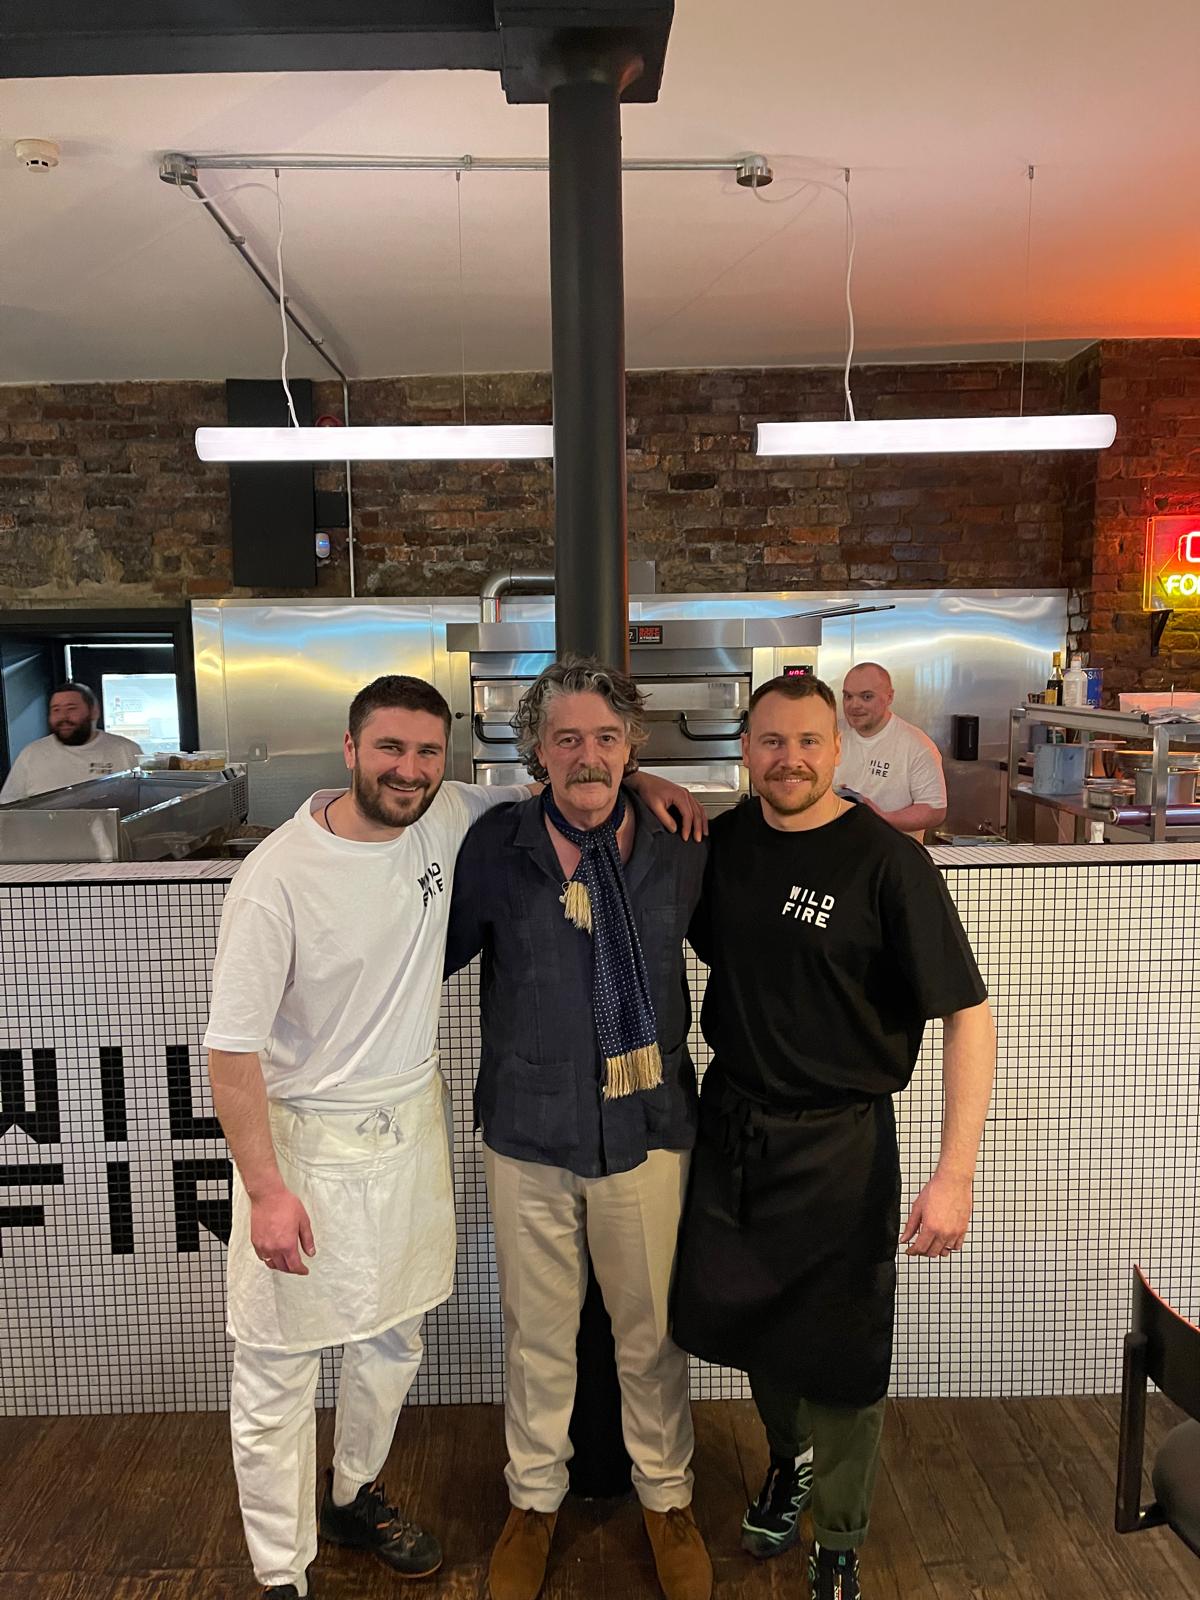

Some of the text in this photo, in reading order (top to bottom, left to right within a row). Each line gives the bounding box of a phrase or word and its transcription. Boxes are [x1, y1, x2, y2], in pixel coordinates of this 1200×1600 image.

[1166, 573, 1200, 596] FO
[870, 760, 890, 770] ILD
[870, 768, 888, 778] IRE
[423, 877, 443, 908] FIE
[789, 885, 835, 911] WILD
[781, 901, 830, 929] FIRE
[0, 1045, 226, 1144] WIL
[0, 1158, 233, 1257] FIR
